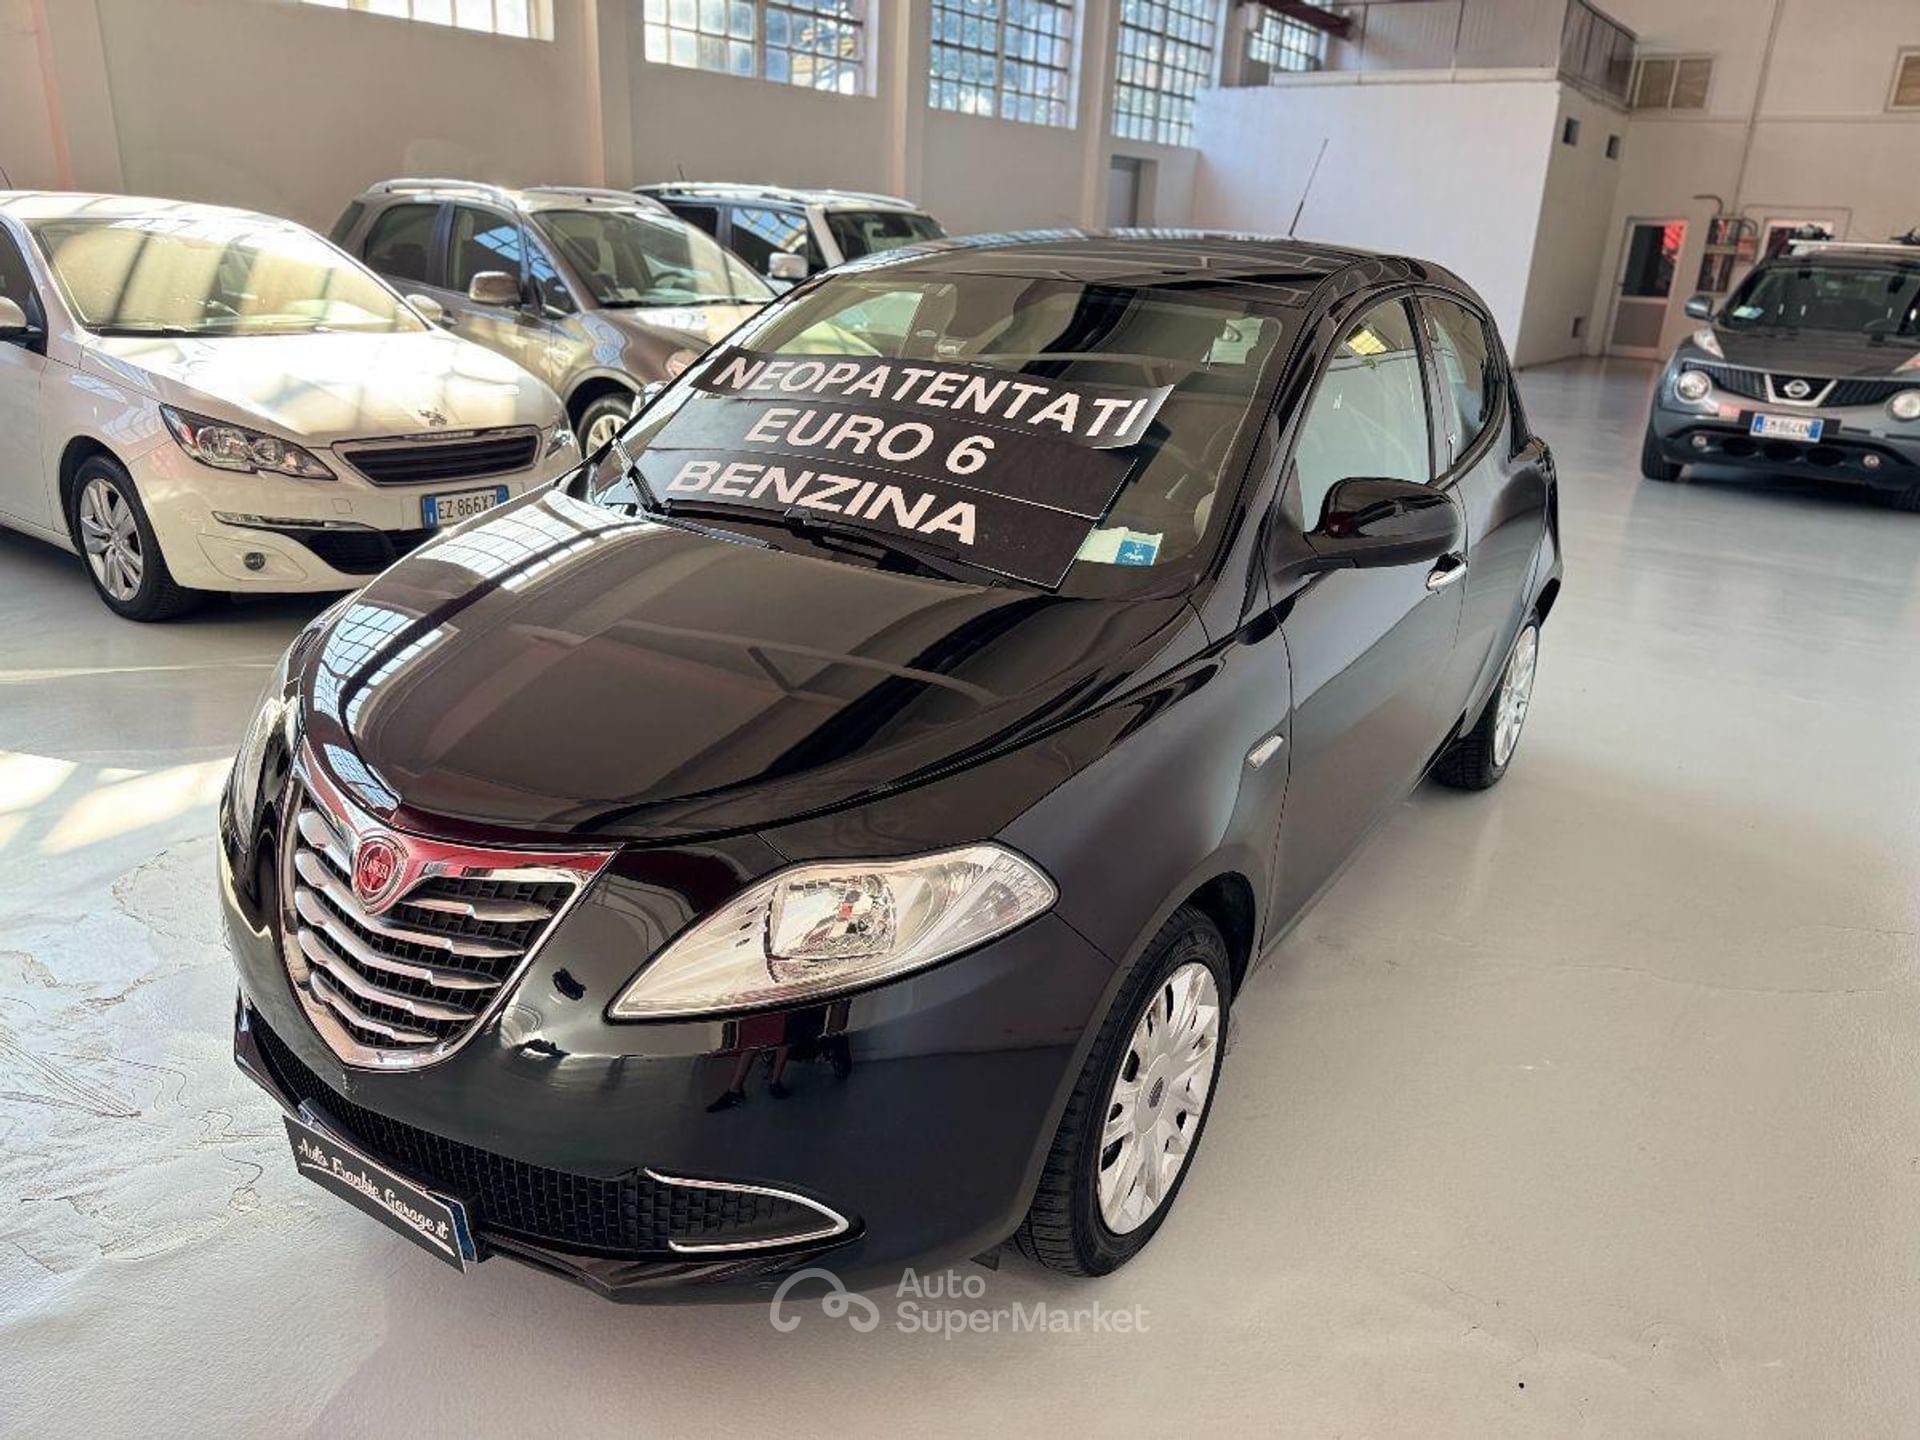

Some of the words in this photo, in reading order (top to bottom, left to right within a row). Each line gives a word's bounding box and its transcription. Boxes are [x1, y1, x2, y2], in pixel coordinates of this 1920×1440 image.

[712, 356, 1149, 438] NEOPATENTATI
[744, 407, 935, 463] EURO
[945, 434, 995, 475] 6
[437, 500, 454, 519] EZ
[666, 460, 976, 545] BENZINA
[298, 1138, 328, 1168] Auto
